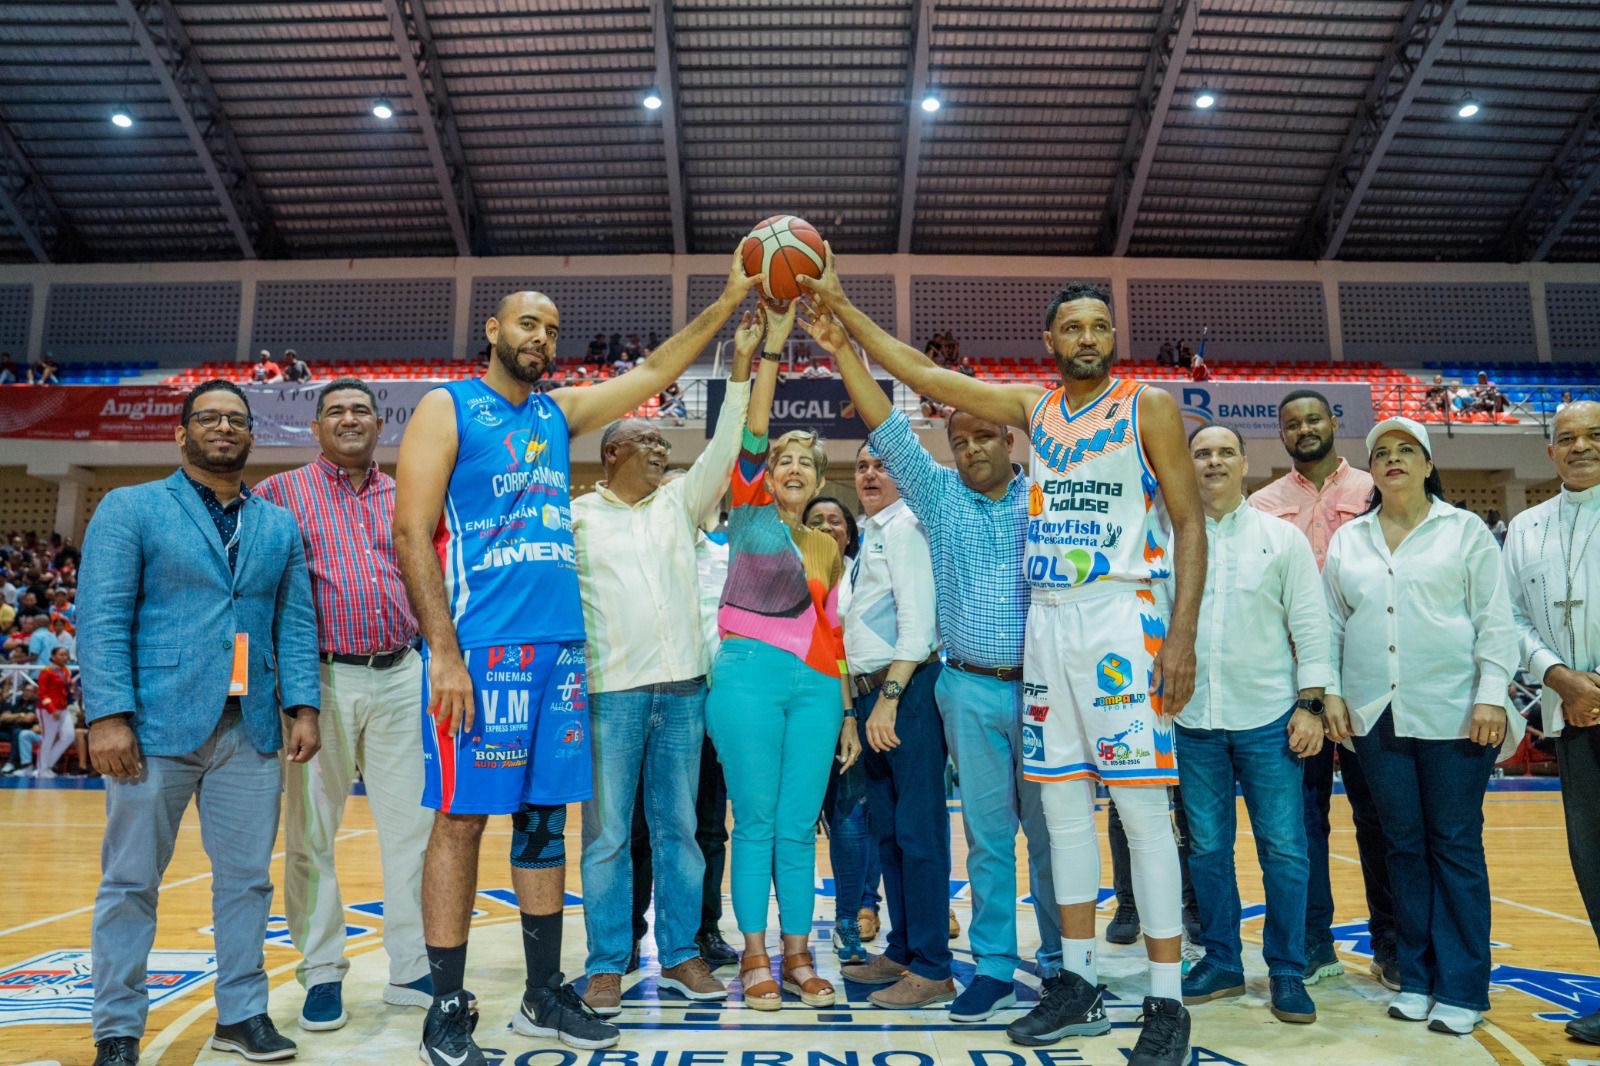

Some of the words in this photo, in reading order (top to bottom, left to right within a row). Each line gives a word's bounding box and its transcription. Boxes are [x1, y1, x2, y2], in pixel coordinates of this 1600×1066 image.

[99, 397, 184, 420] Angime
[767, 401, 836, 419] UGAL
[1218, 404, 1344, 418] BANRES
[1042, 479, 1123, 498] Empana
[465, 517, 497, 532] EMIL
[471, 541, 577, 571] JIMENE
[486, 671, 533, 682] CINEMAS
